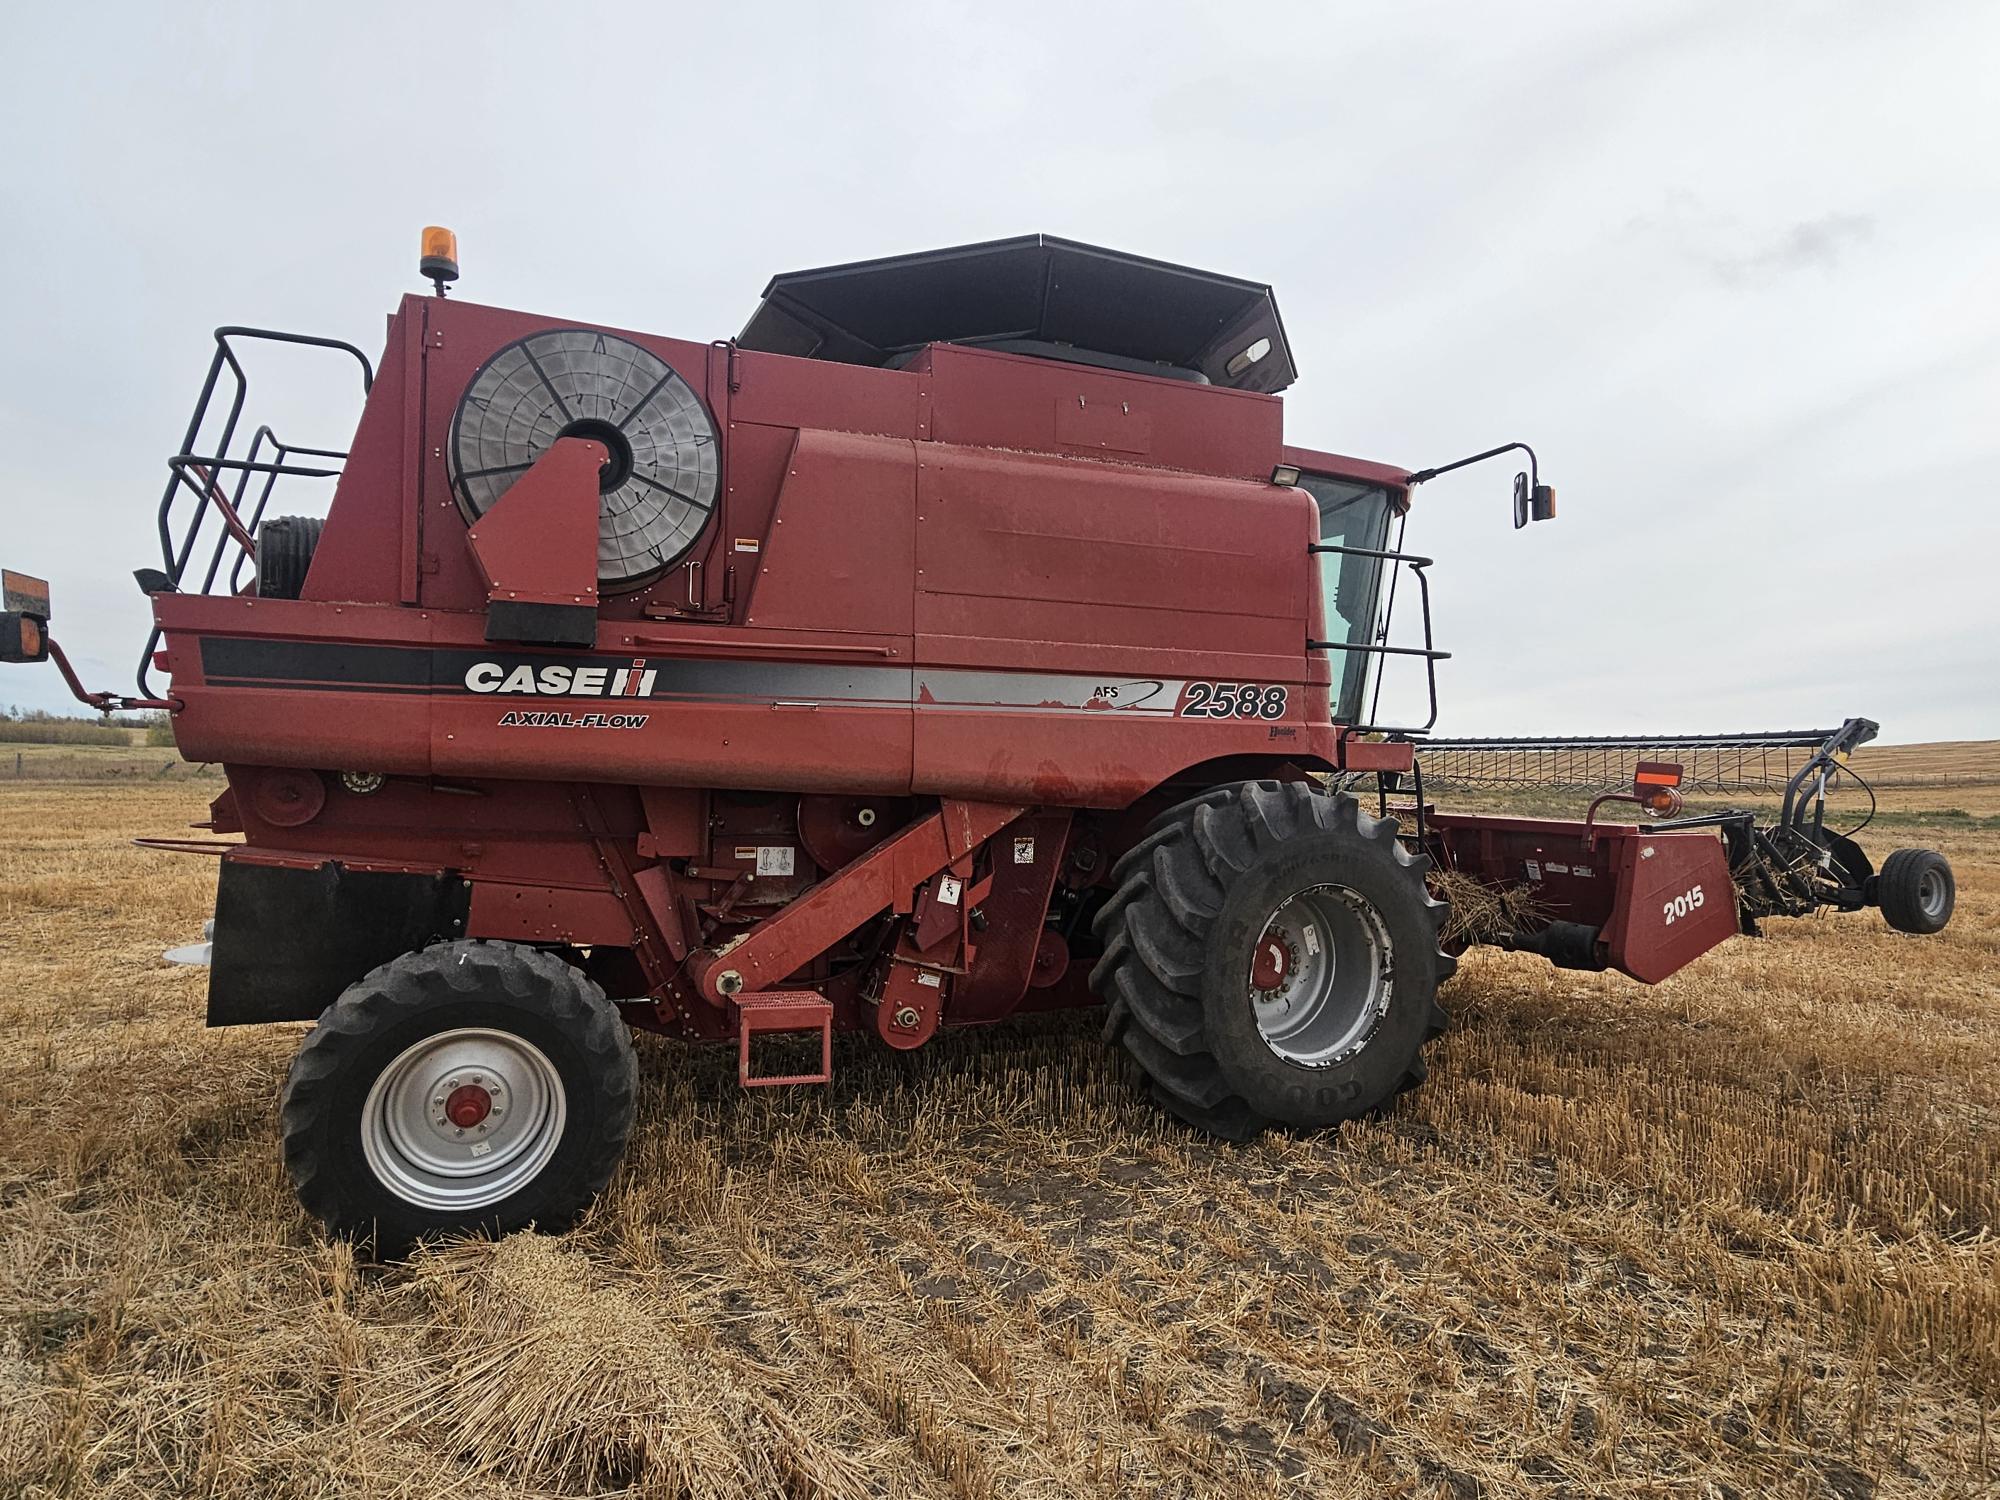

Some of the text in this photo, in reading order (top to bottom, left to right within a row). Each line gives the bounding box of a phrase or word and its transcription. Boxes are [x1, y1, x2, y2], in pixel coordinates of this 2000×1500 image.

[464, 662, 608, 696] CASE
[1093, 686, 1119, 698] AFS
[1180, 681, 1288, 721] 2588
[498, 711, 649, 729] AXIAL-FLOW
[1663, 884, 1704, 926] 2015
